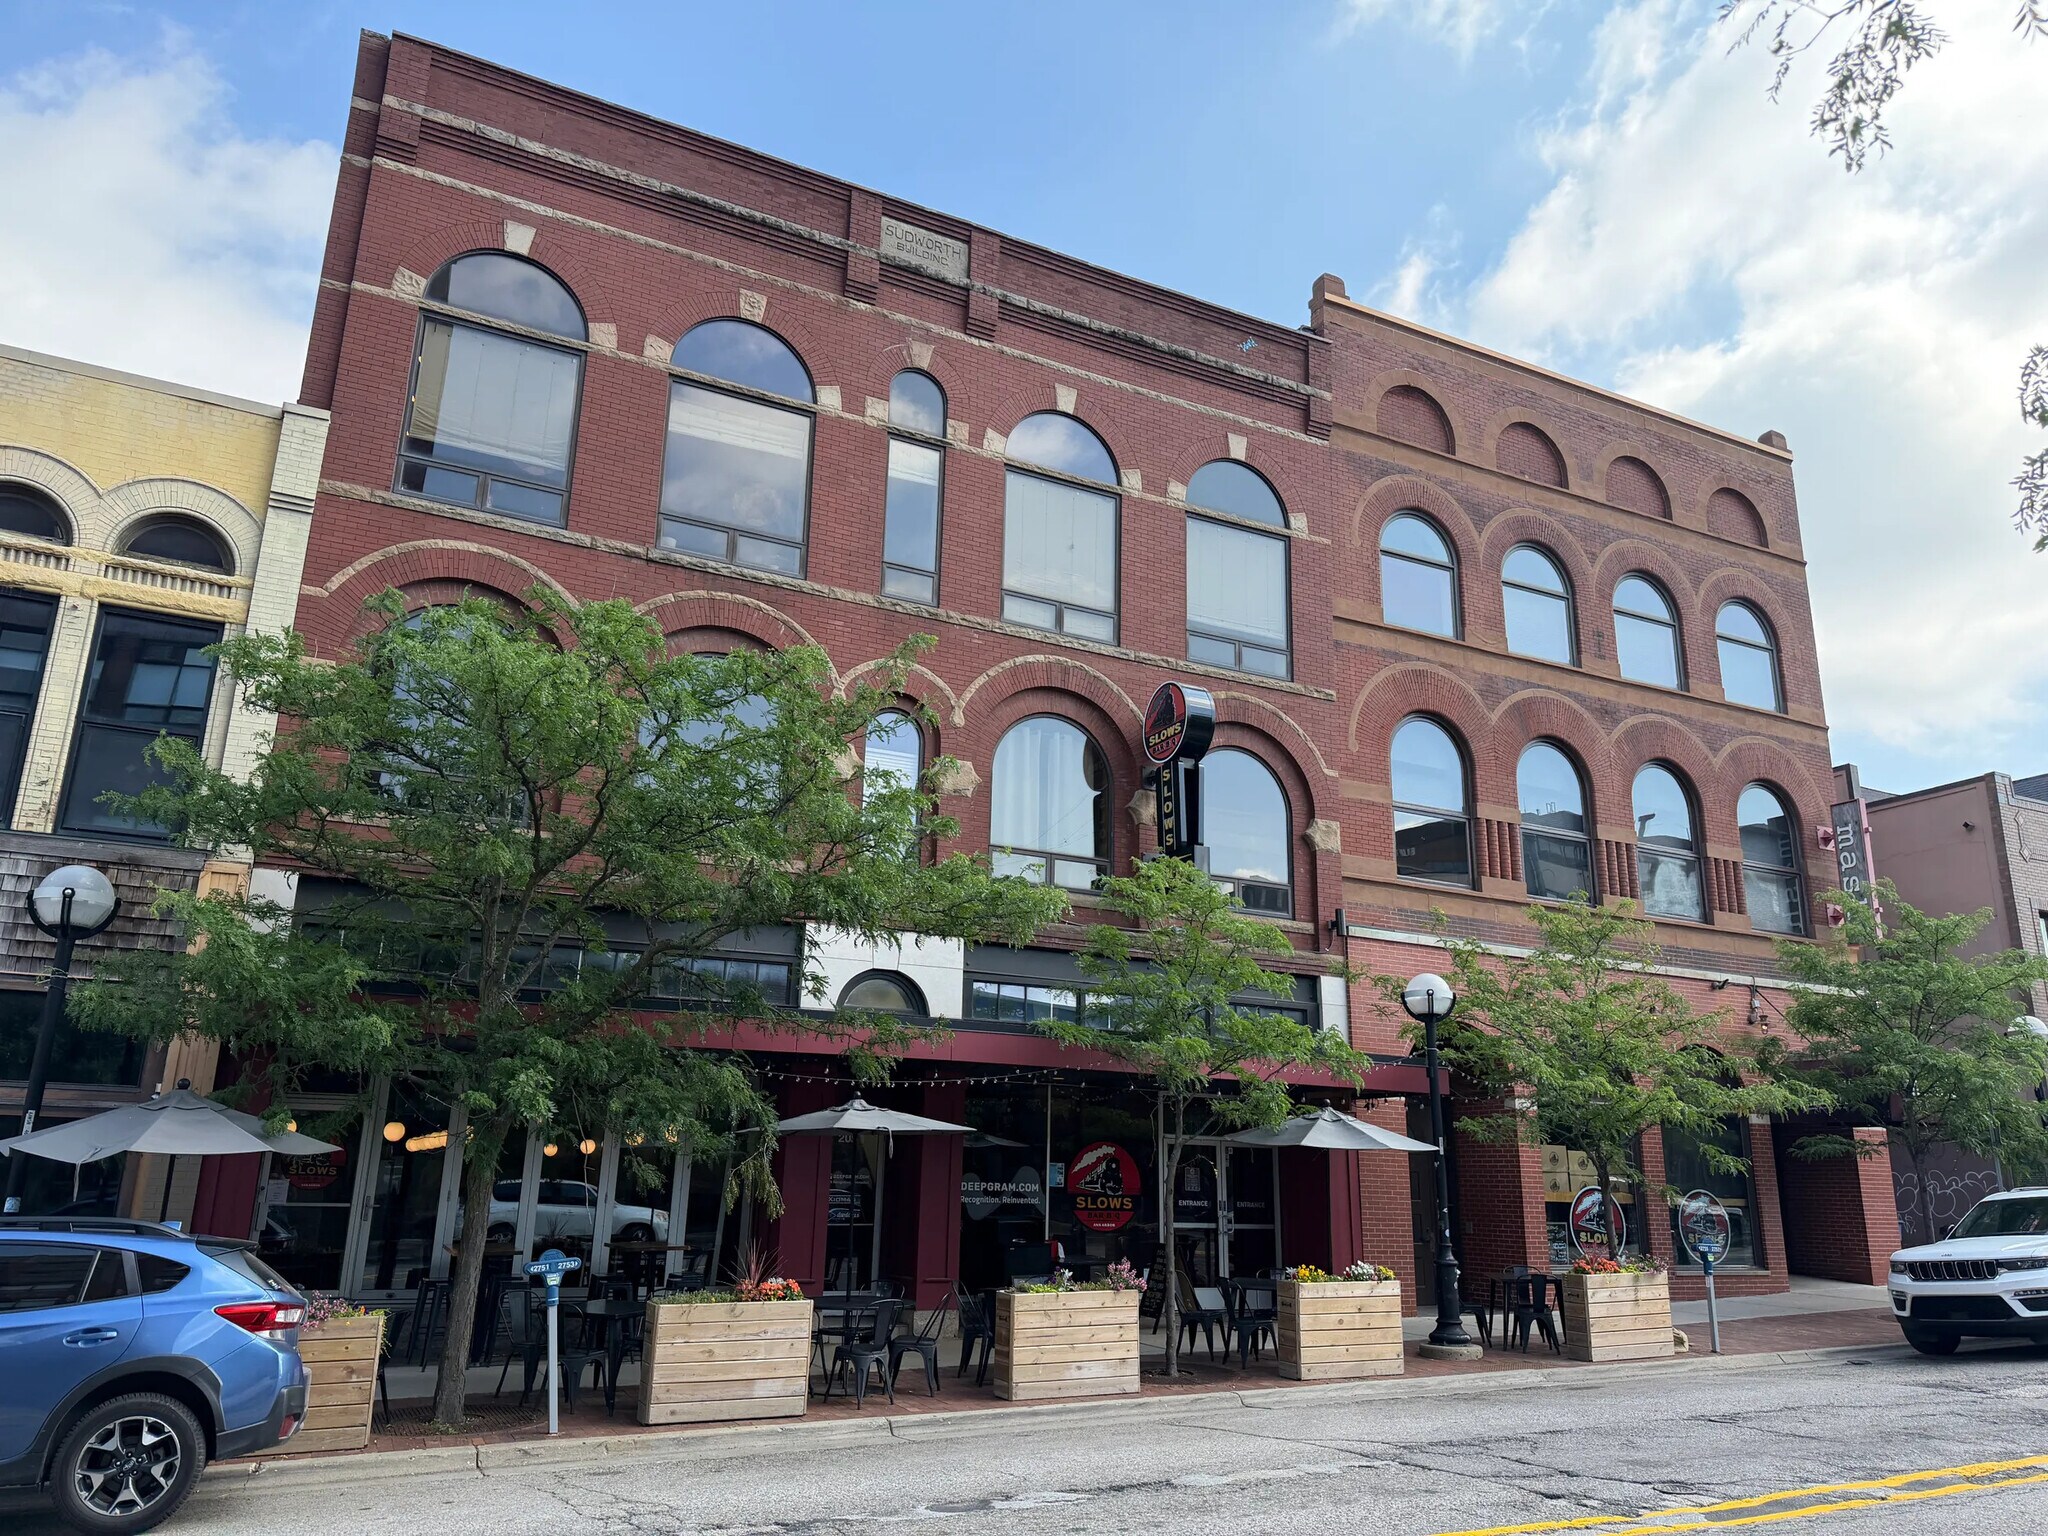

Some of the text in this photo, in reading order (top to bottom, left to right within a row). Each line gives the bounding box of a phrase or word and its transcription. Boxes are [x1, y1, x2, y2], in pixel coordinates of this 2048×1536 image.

[885, 224, 961, 259] SUDWORTH
[896, 242, 949, 267] BUILDING
[1149, 722, 1181, 746] SLOWS
[1162, 769, 1174, 845] SLOWS
[289, 1166, 337, 1175] SLOWS
[961, 1182, 1039, 1192] DEEPGRAM.COM
[961, 1196, 1041, 1205] Recognition. Reinvented.
[1076, 1196, 1133, 1210] SLOWS
[1236, 1201, 1265, 1209] ENTRANCE
[533, 1261, 575, 1272] 2751 2753
